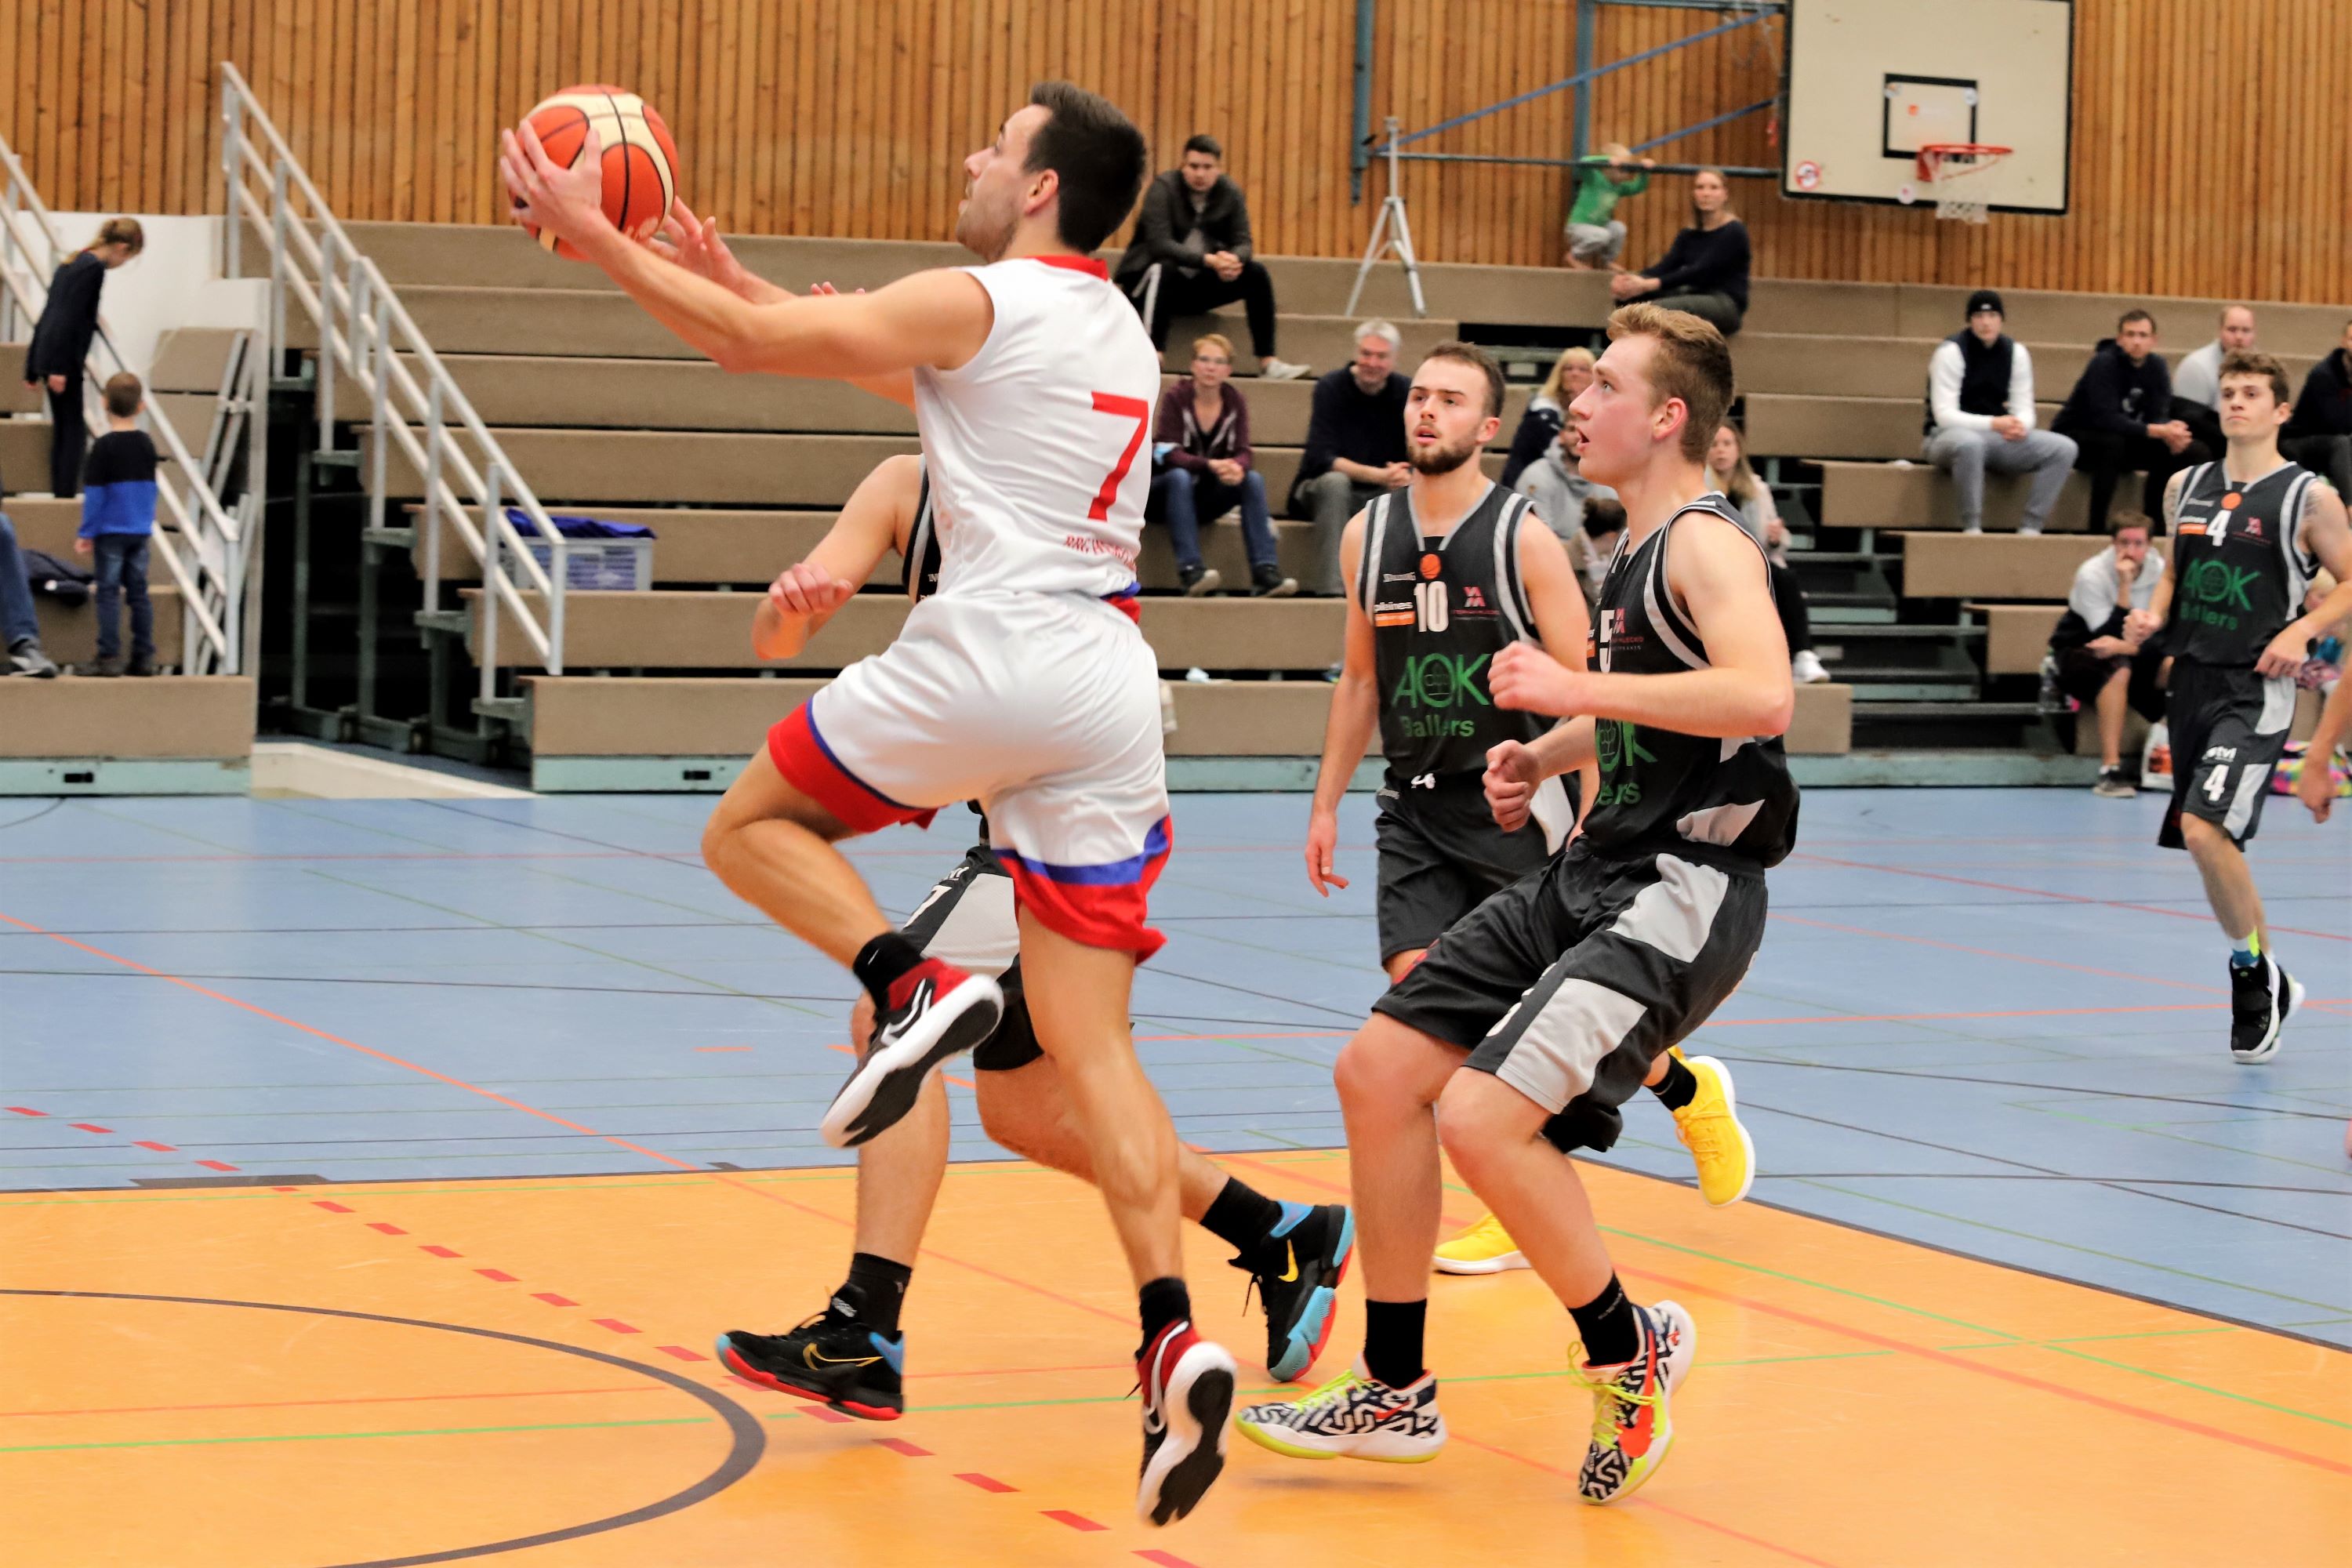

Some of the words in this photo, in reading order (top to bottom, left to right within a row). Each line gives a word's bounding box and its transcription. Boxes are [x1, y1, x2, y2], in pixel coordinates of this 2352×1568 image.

[1088, 391, 1149, 523] 7
[2205, 509, 2232, 546] 4
[1414, 580, 1449, 632] 10
[1391, 652, 1492, 708] AOK
[1595, 720, 1657, 772] OK
[2203, 764, 2230, 801] 4
[903, 884, 953, 928] 7
